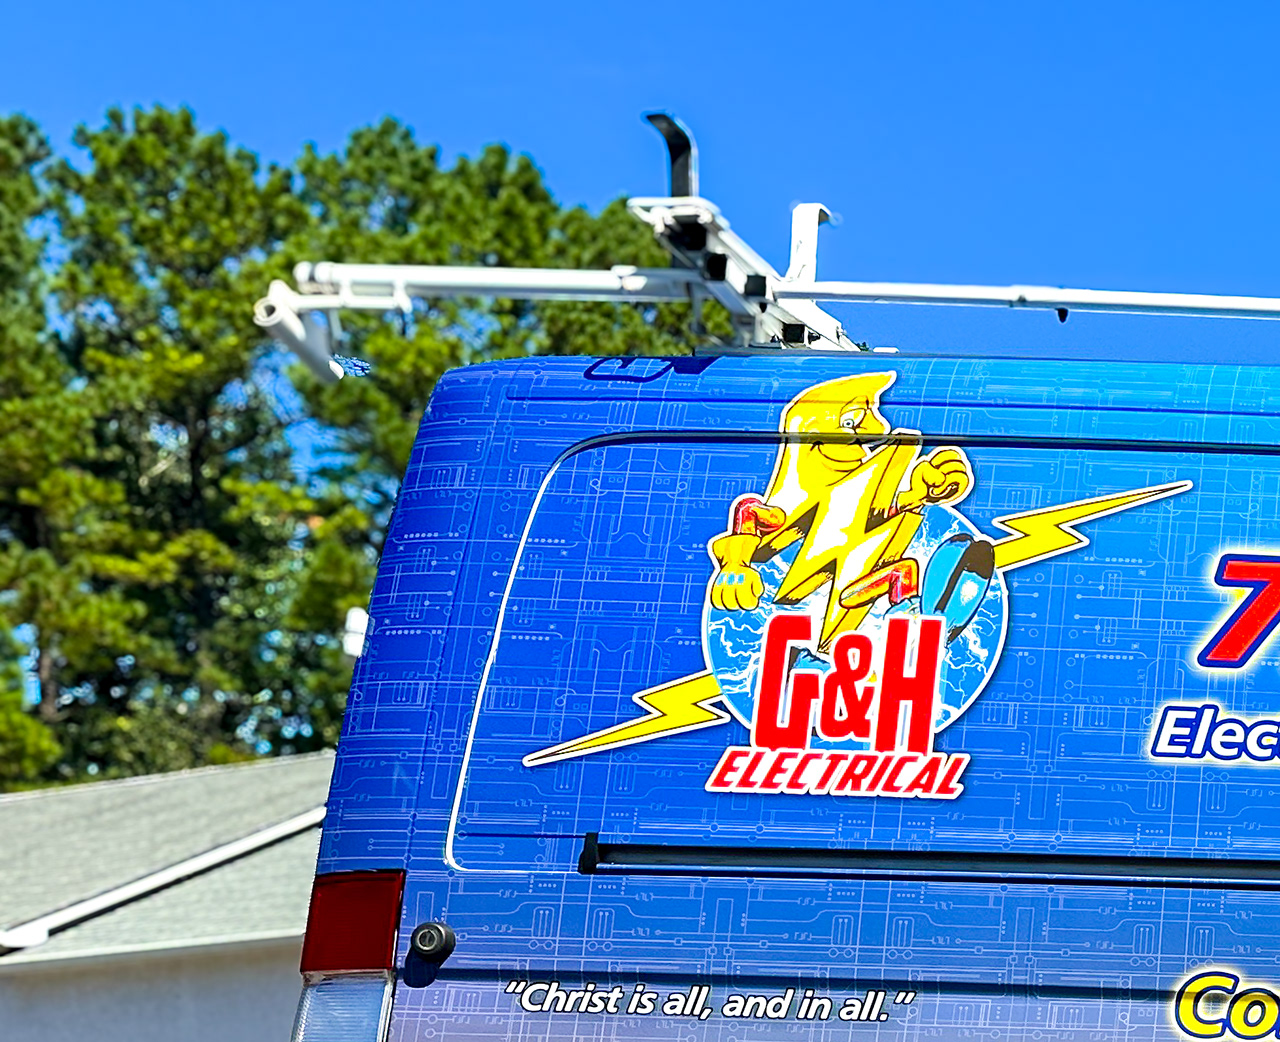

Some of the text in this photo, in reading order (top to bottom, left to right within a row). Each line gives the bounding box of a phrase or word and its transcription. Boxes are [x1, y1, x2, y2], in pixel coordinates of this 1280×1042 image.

[752, 614, 944, 756] G&H
[709, 750, 966, 798] ELECTRICAL
[505, 981, 916, 1023] “Christ is all, and in all.”
